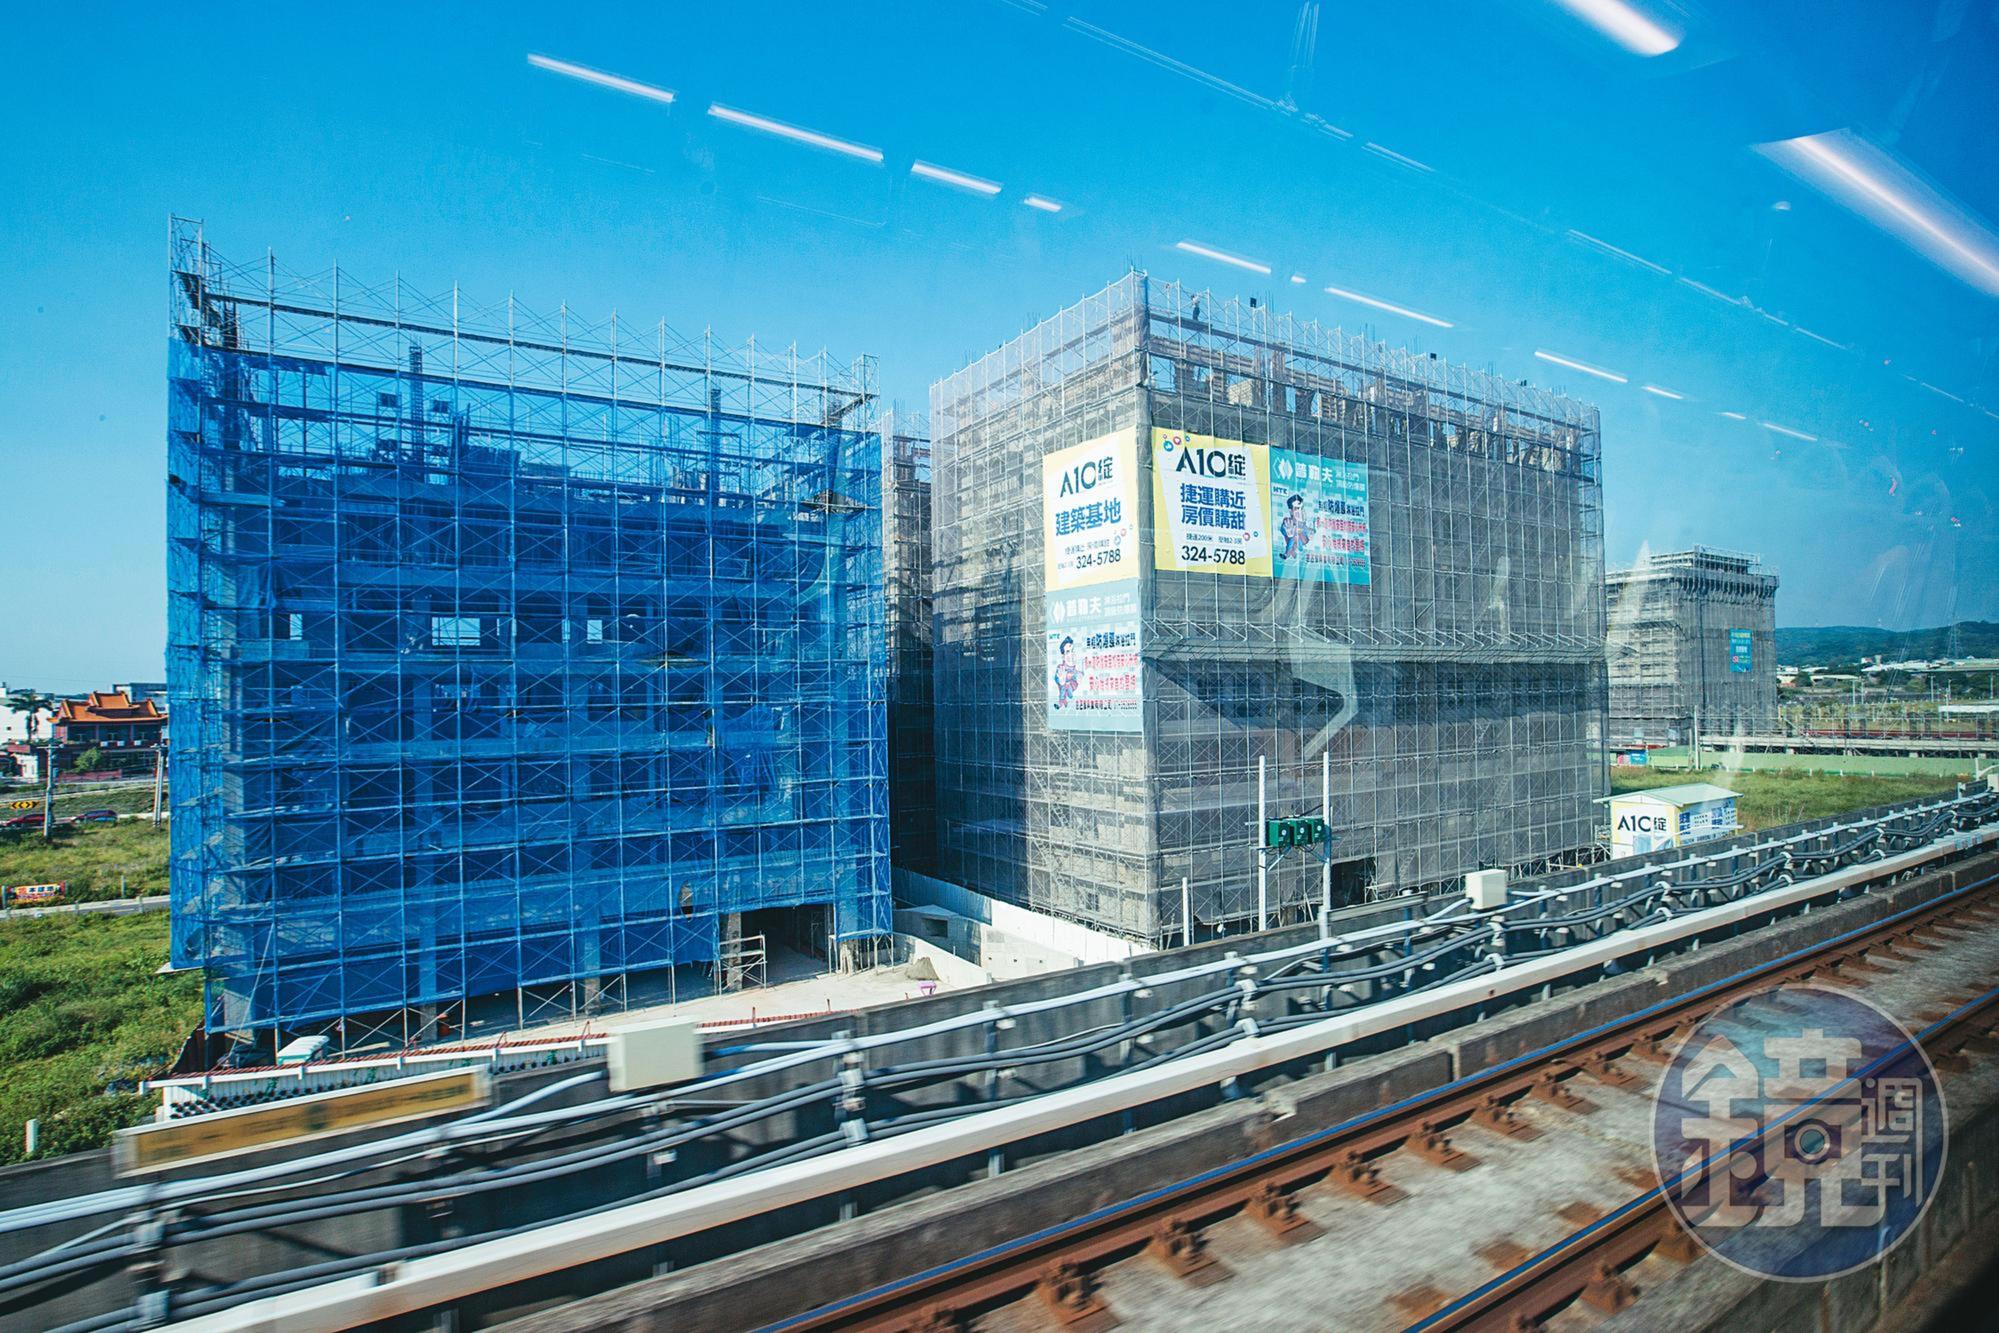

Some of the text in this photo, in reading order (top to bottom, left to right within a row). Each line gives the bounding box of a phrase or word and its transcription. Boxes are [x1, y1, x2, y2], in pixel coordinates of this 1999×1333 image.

[1180, 483, 1246, 510] 捷運購近
[1055, 497, 1121, 536] 建築基地
[1181, 505, 1246, 530] 房價購甜
[1076, 548, 1121, 569] 324-5788
[1181, 545, 1246, 565] 324-5788
